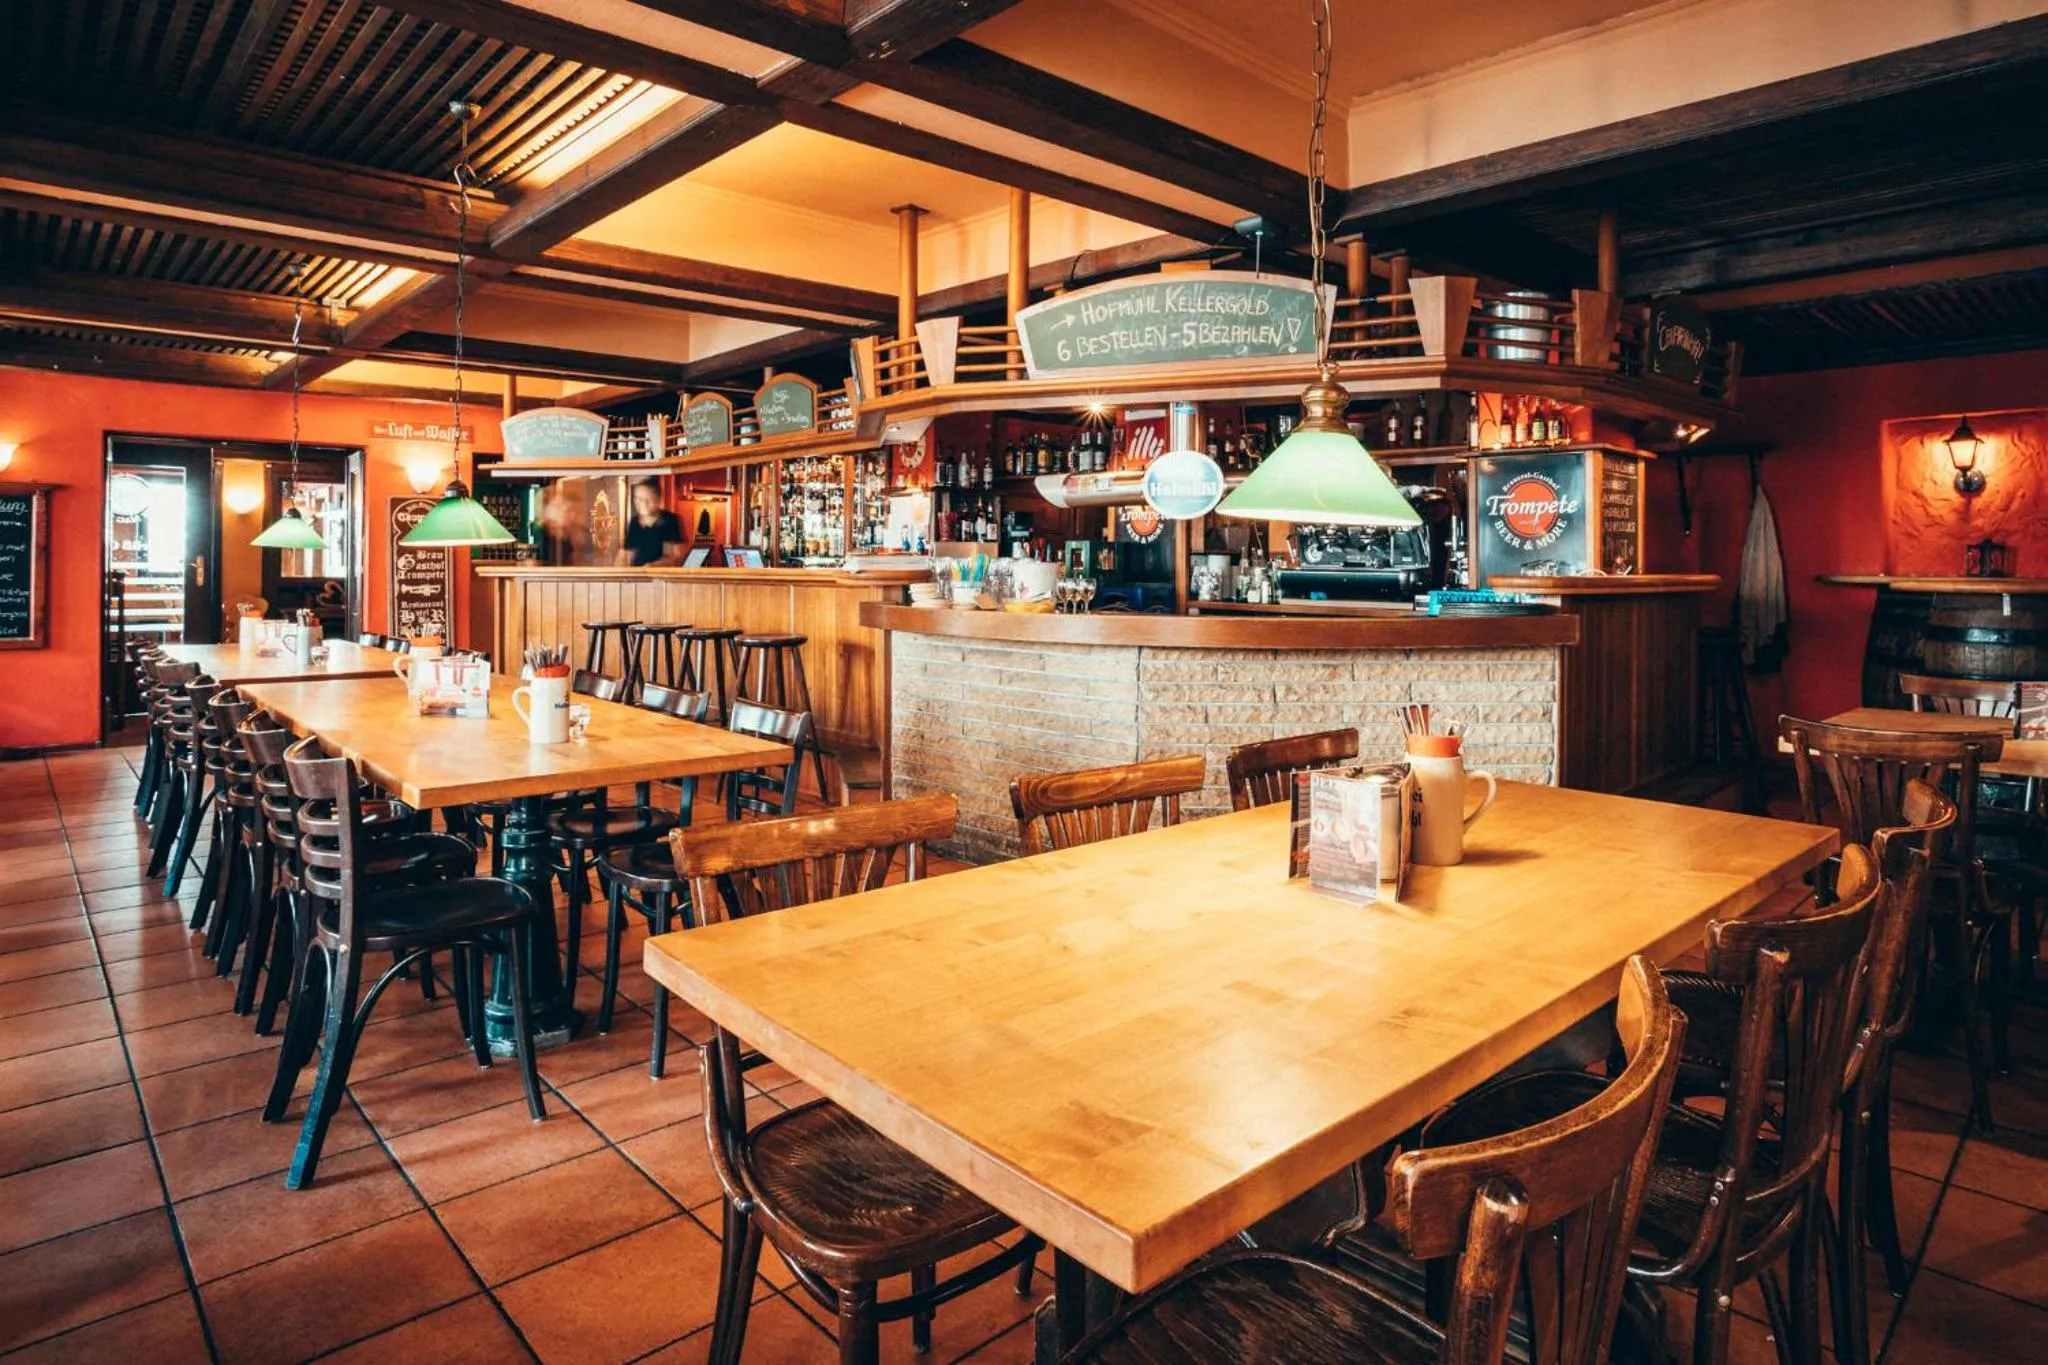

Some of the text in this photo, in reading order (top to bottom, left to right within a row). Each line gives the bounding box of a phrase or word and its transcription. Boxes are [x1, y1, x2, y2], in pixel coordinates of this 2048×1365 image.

[1165, 287, 1270, 316] KELLERGOLD
[1057, 342, 1070, 361] 6
[1076, 326, 1169, 359] BESTELLEN
[1182, 323, 1196, 346] 5
[1486, 493, 1579, 529] Trompete
[1494, 519, 1568, 550] BEER & MORE
[398, 570, 445, 579] Trompete
